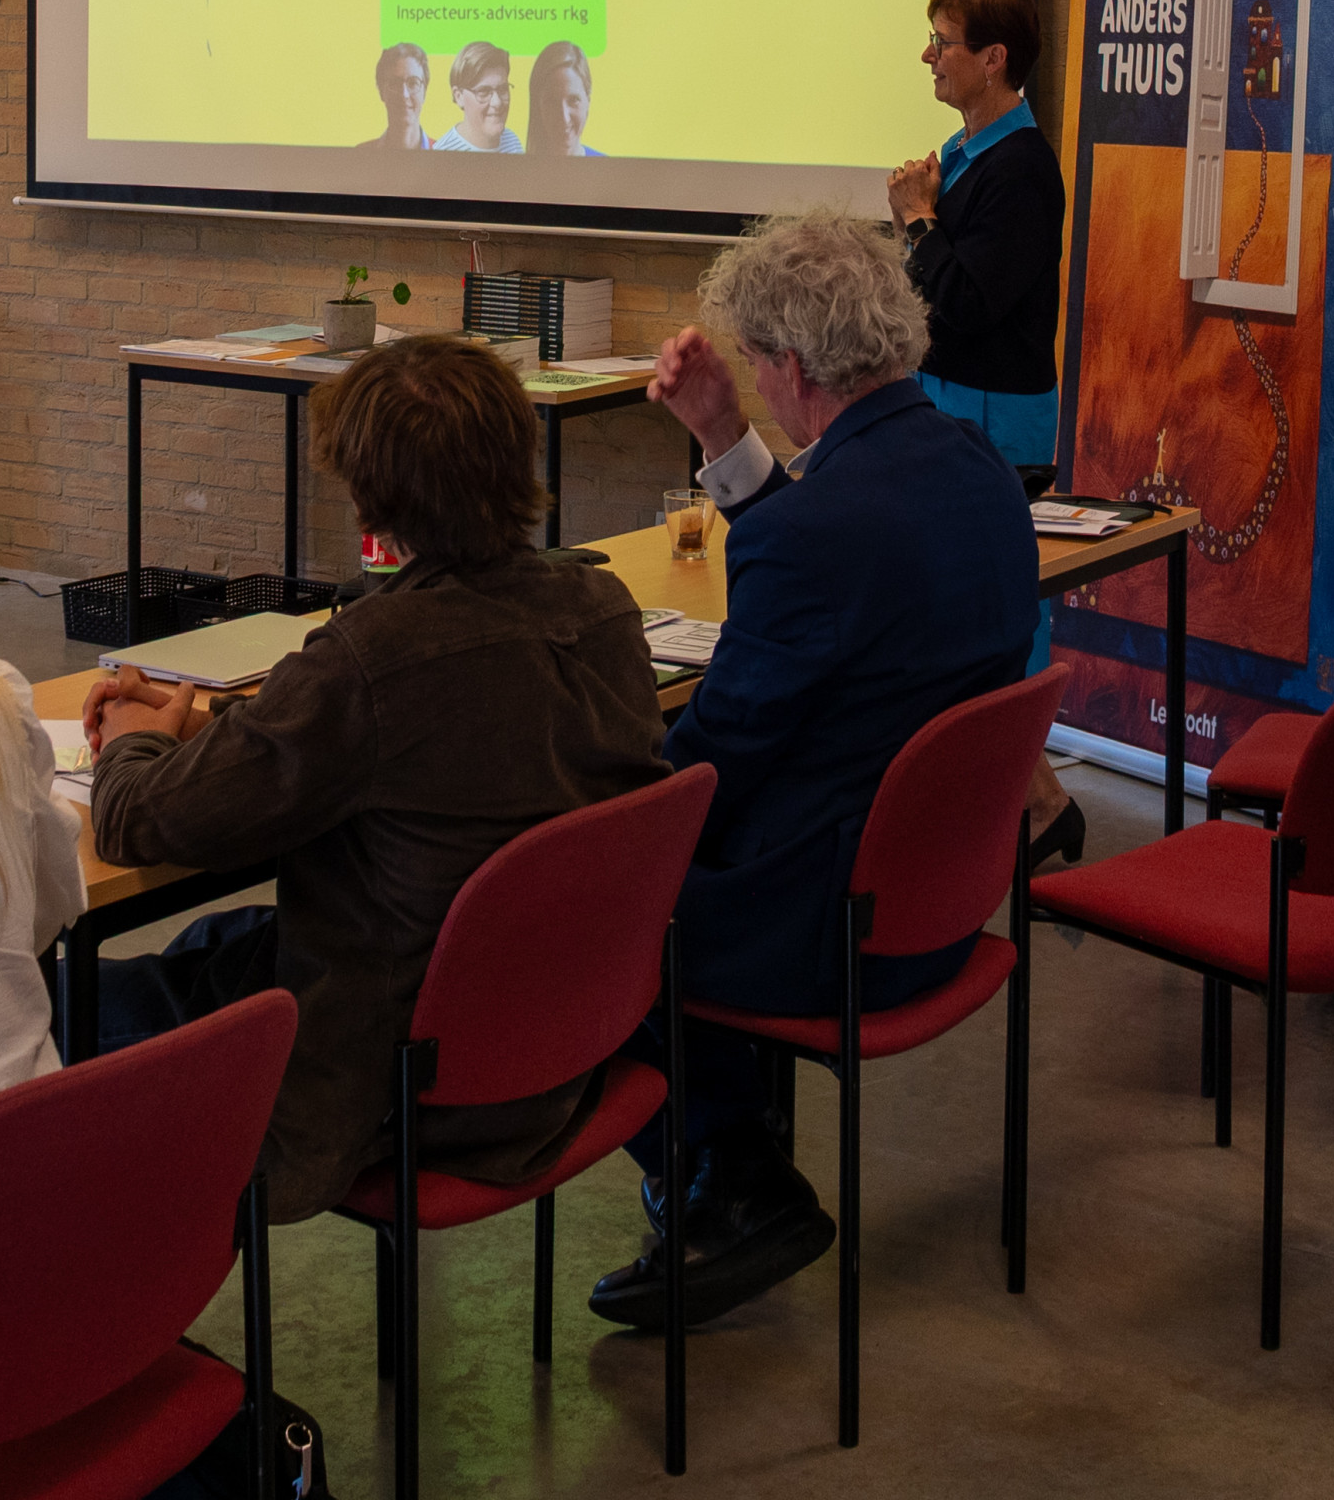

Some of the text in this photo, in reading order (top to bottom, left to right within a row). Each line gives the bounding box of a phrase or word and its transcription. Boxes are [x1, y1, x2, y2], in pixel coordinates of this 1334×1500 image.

[396, 5, 588, 25] Inspecteurs-adviseurs rkg
[1098, 42, 1185, 96] THUIS
[1150, 698, 1217, 740] Leocht
